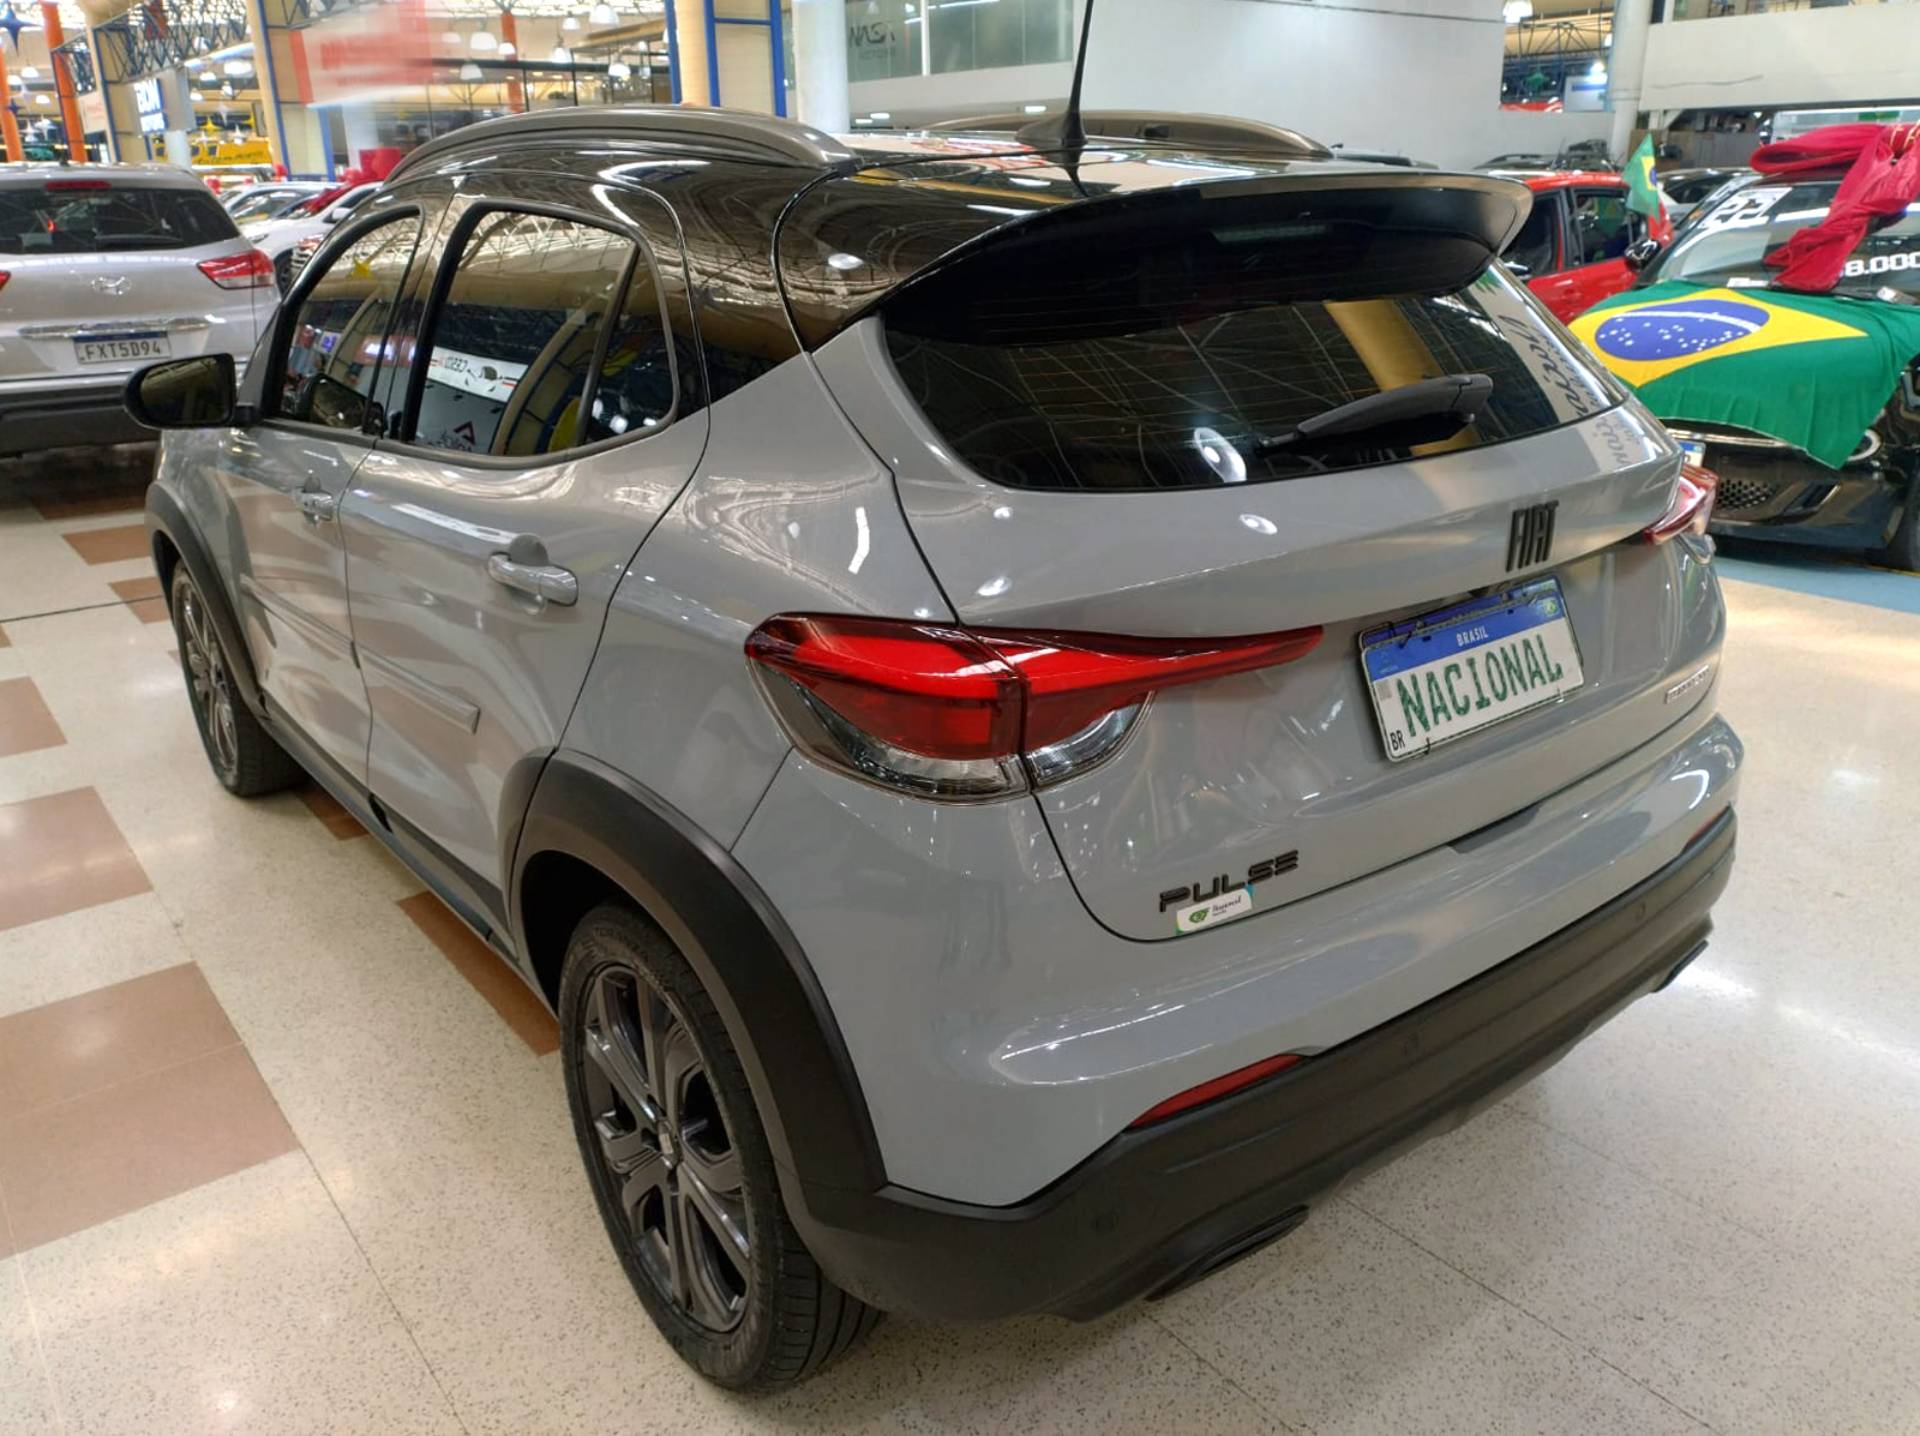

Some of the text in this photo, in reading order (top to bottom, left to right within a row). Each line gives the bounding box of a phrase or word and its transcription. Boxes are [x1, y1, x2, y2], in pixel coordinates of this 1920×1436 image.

[1841, 251, 1920, 277] 8.000
[84, 341, 161, 360] FXT5D94
[1506, 500, 1559, 573] FIAT
[1456, 626, 1489, 647] BRASIL
[1396, 634, 1564, 738] NACIONAL
[1390, 730, 1406, 751] BR
[1159, 850, 1299, 913] PULSE
